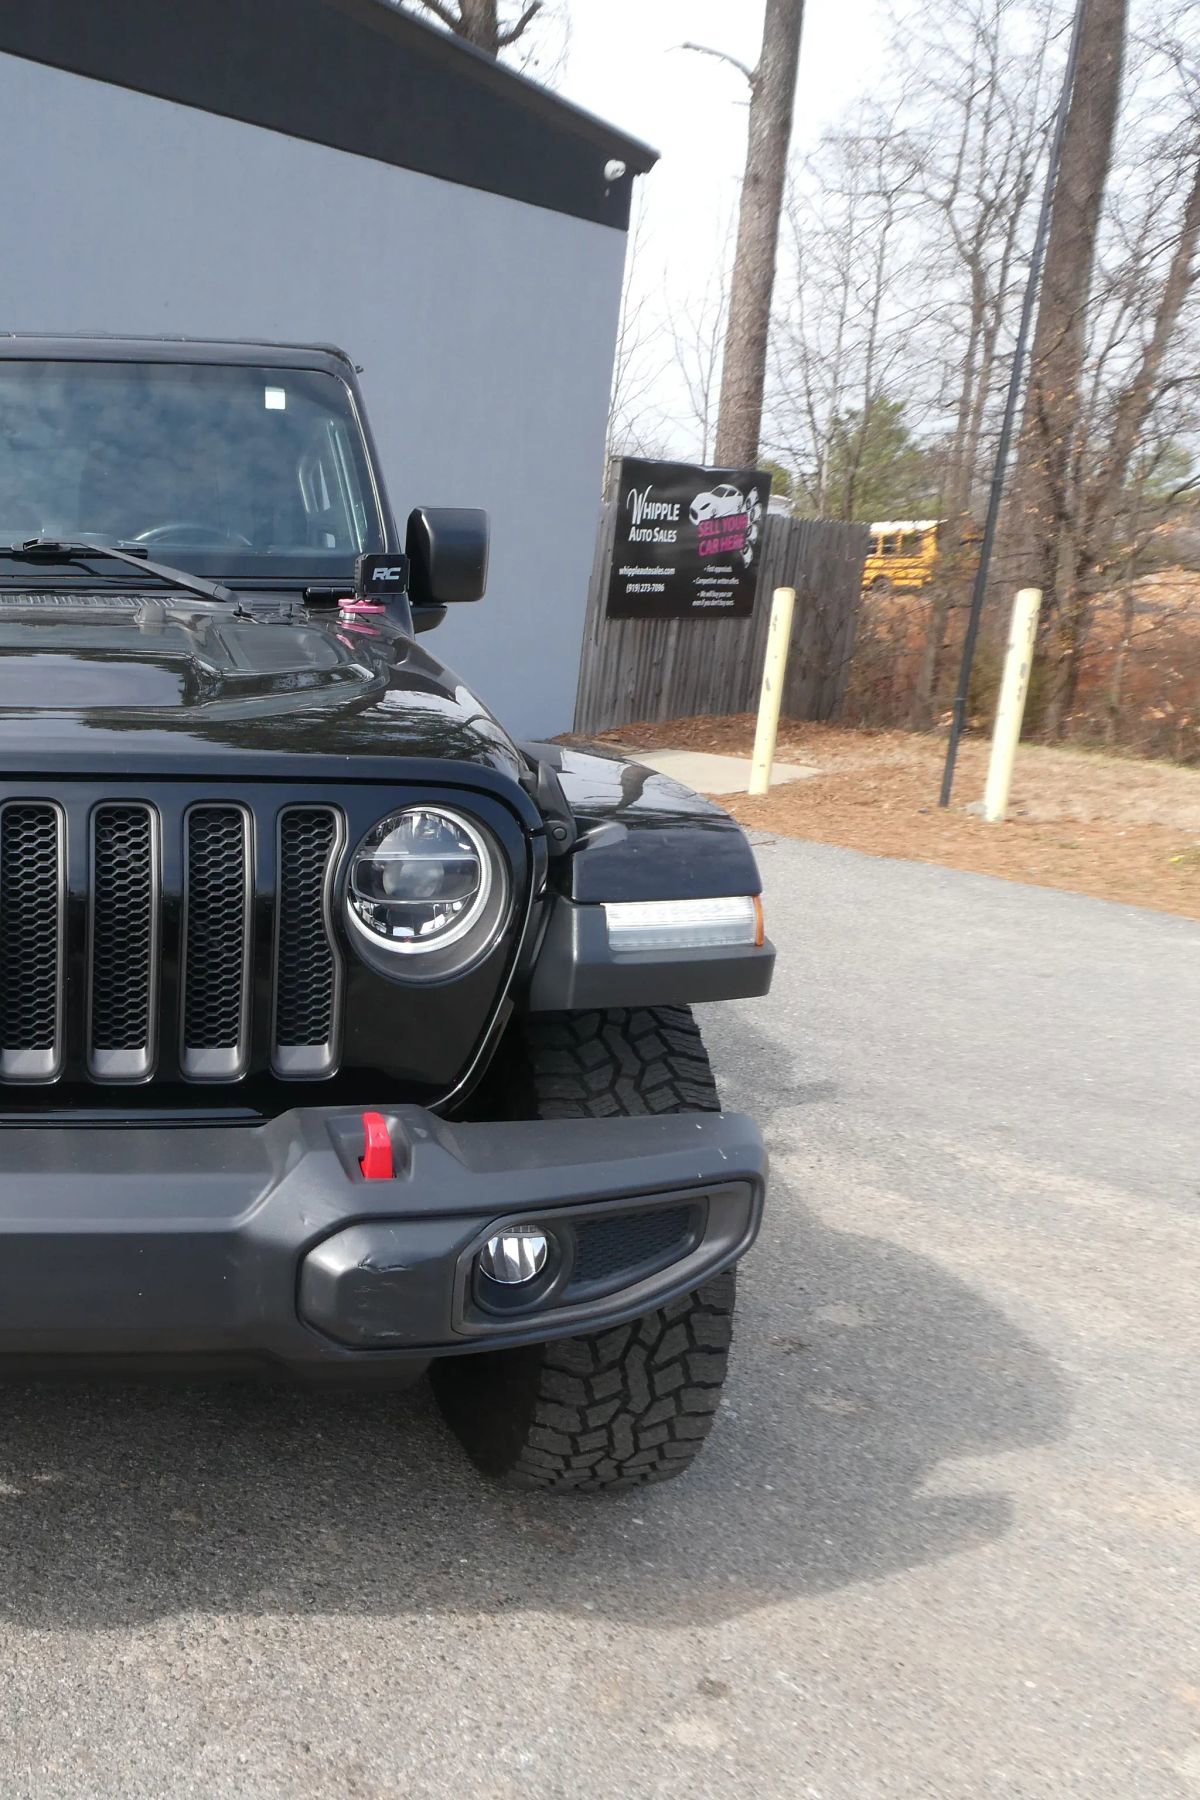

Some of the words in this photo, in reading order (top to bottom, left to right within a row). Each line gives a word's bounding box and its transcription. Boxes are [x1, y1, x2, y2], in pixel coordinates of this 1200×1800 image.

[629, 526, 652, 541] AUTO
[653, 527, 677, 542] SALES
[698, 537, 720, 556] CAR
[372, 567, 401, 580] RC
